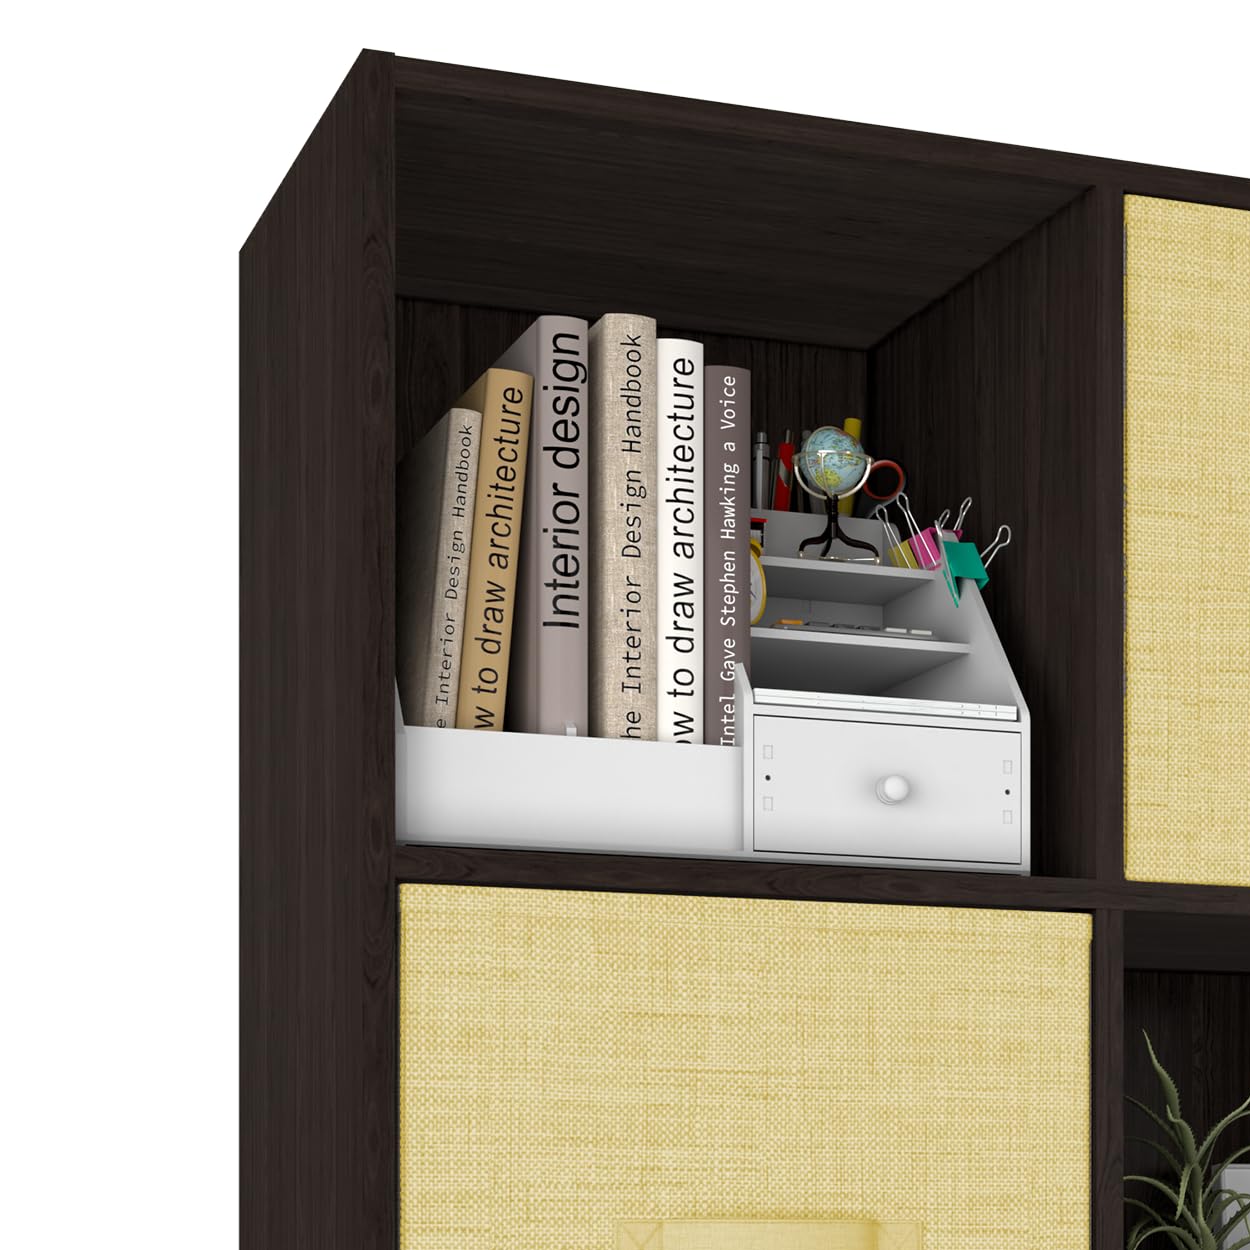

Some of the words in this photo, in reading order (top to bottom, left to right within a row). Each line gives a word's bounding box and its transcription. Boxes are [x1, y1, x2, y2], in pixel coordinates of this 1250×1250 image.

[542, 332, 587, 470] design
[620, 333, 642, 454] Handbook
[720, 375, 736, 430] Voice
[451, 424, 473, 518] Handbook
[486, 386, 523, 570] architecture
[666, 356, 694, 560] architecture
[723, 440, 736, 452] a
[620, 469, 647, 559] Design
[720, 463, 740, 540] Hawking
[444, 528, 466, 600] Design
[542, 482, 580, 629] Interior
[719, 541, 740, 627] Stephen
[474, 580, 506, 655] draw
[620, 575, 642, 694] Interior
[666, 572, 694, 655] draw
[435, 613, 456, 705] Interior
[472, 667, 498, 694] to
[667, 668, 694, 698] to
[720, 638, 736, 681] Gave
[620, 711, 642, 739] he
[719, 694, 736, 746] Intel
